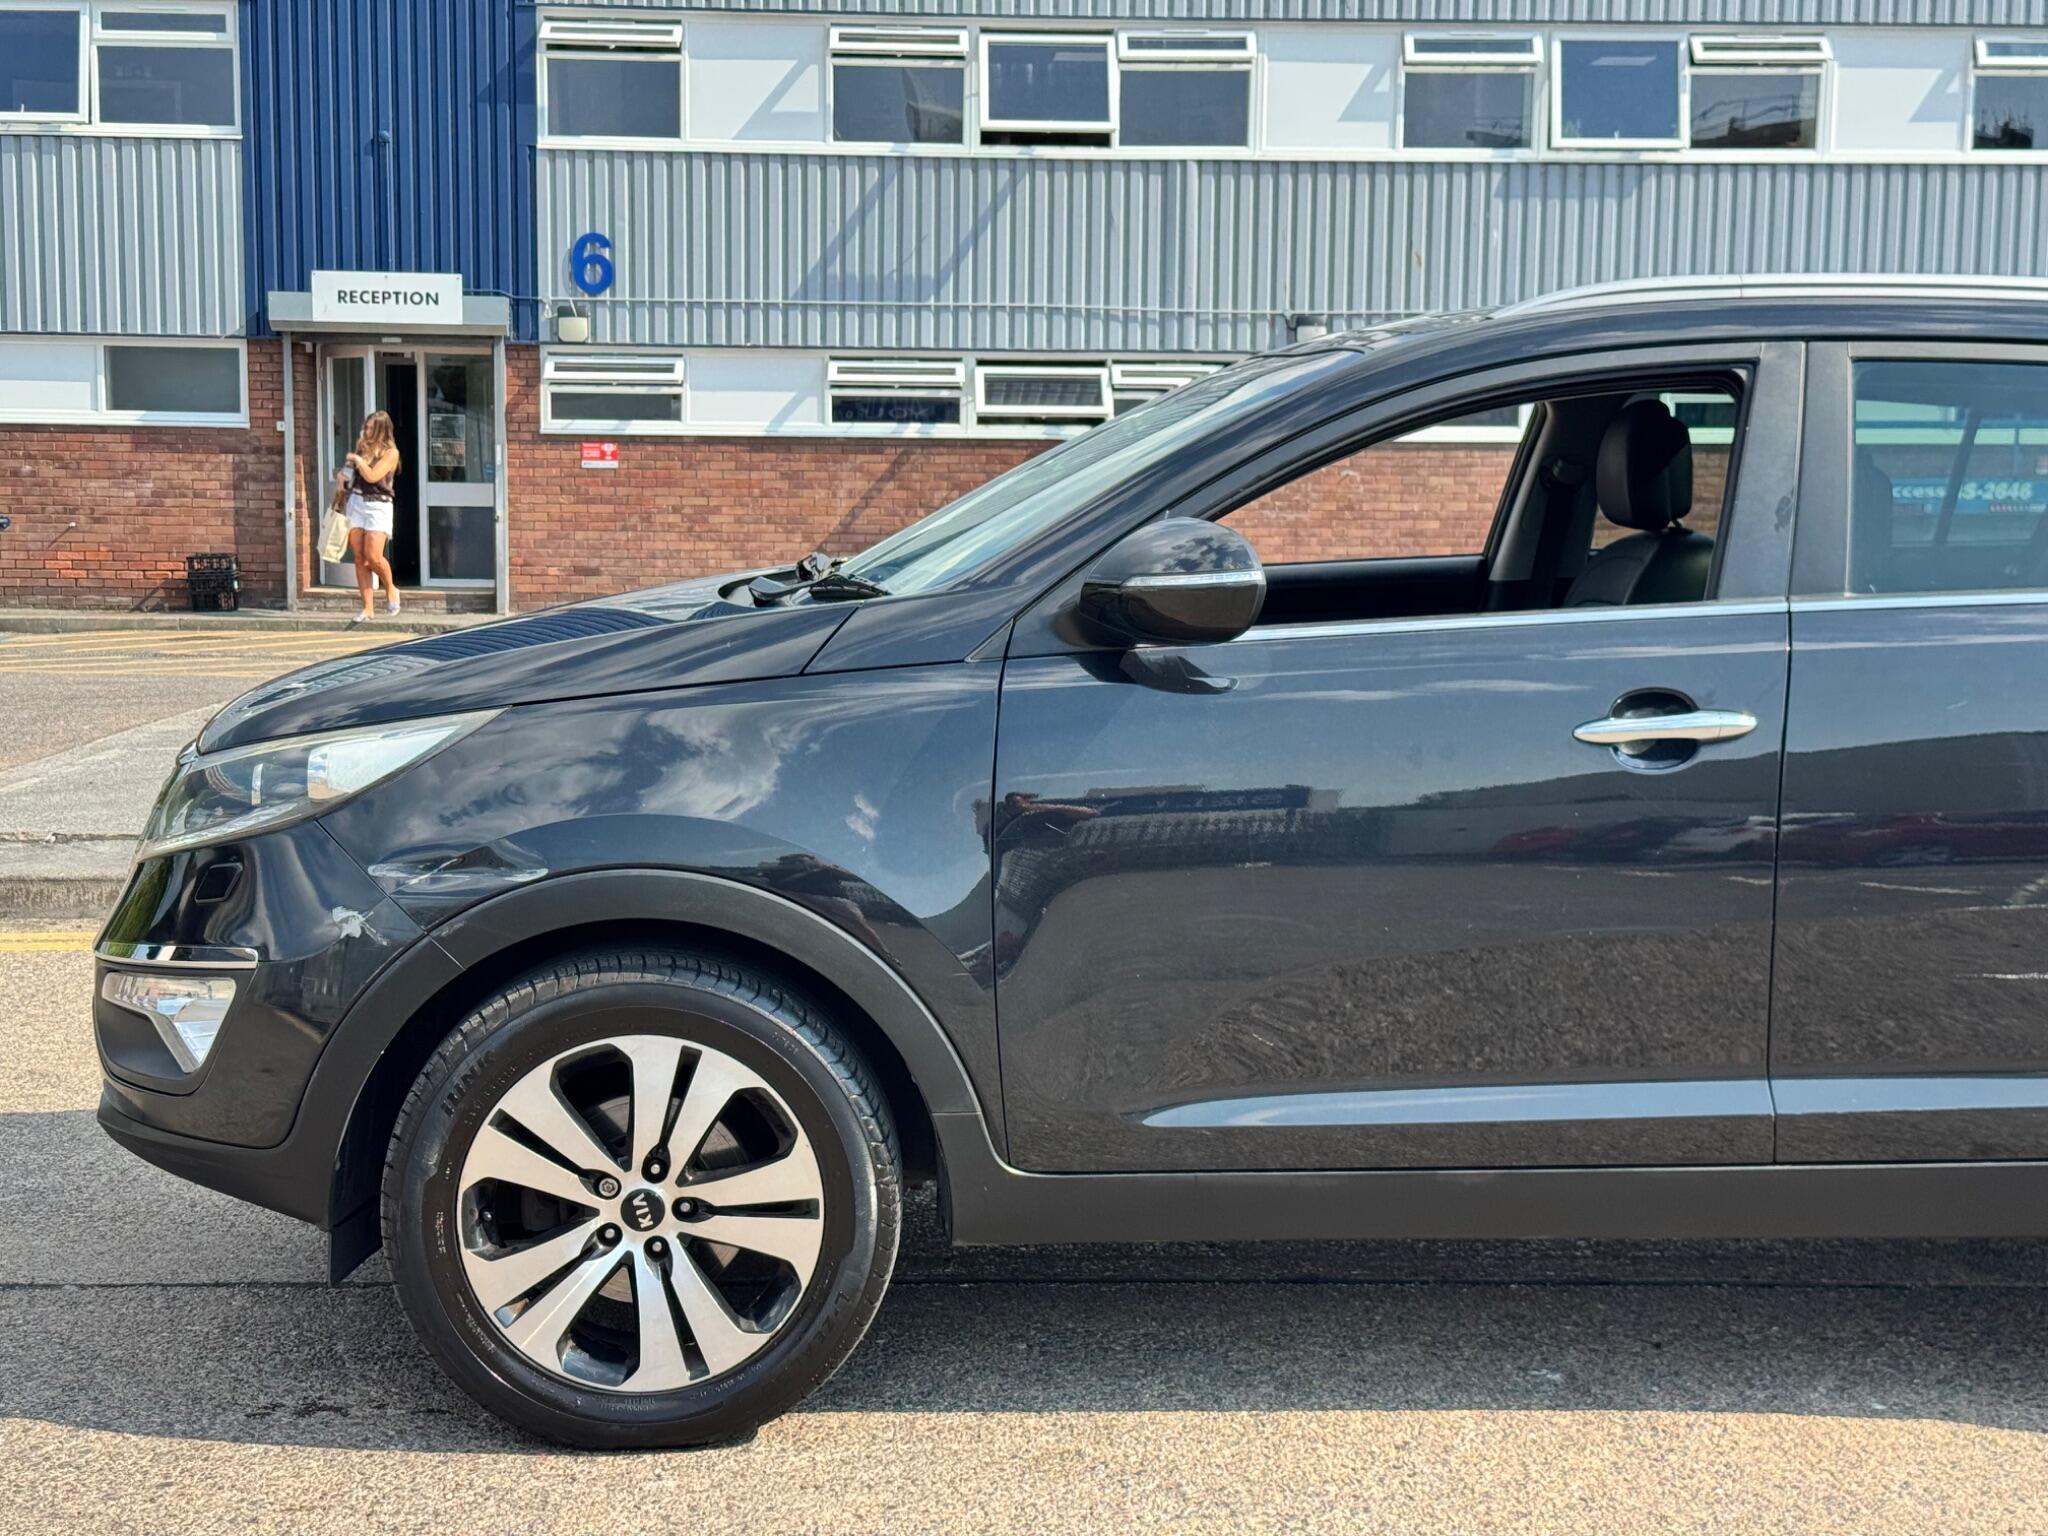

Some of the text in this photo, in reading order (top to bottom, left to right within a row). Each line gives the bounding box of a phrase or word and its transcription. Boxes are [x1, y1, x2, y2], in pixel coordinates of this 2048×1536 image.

[572, 232, 613, 297] 6
[337, 290, 440, 306] RECEPTION
[1892, 486, 1946, 499] ccess
[632, 1192, 654, 1229] KIA
